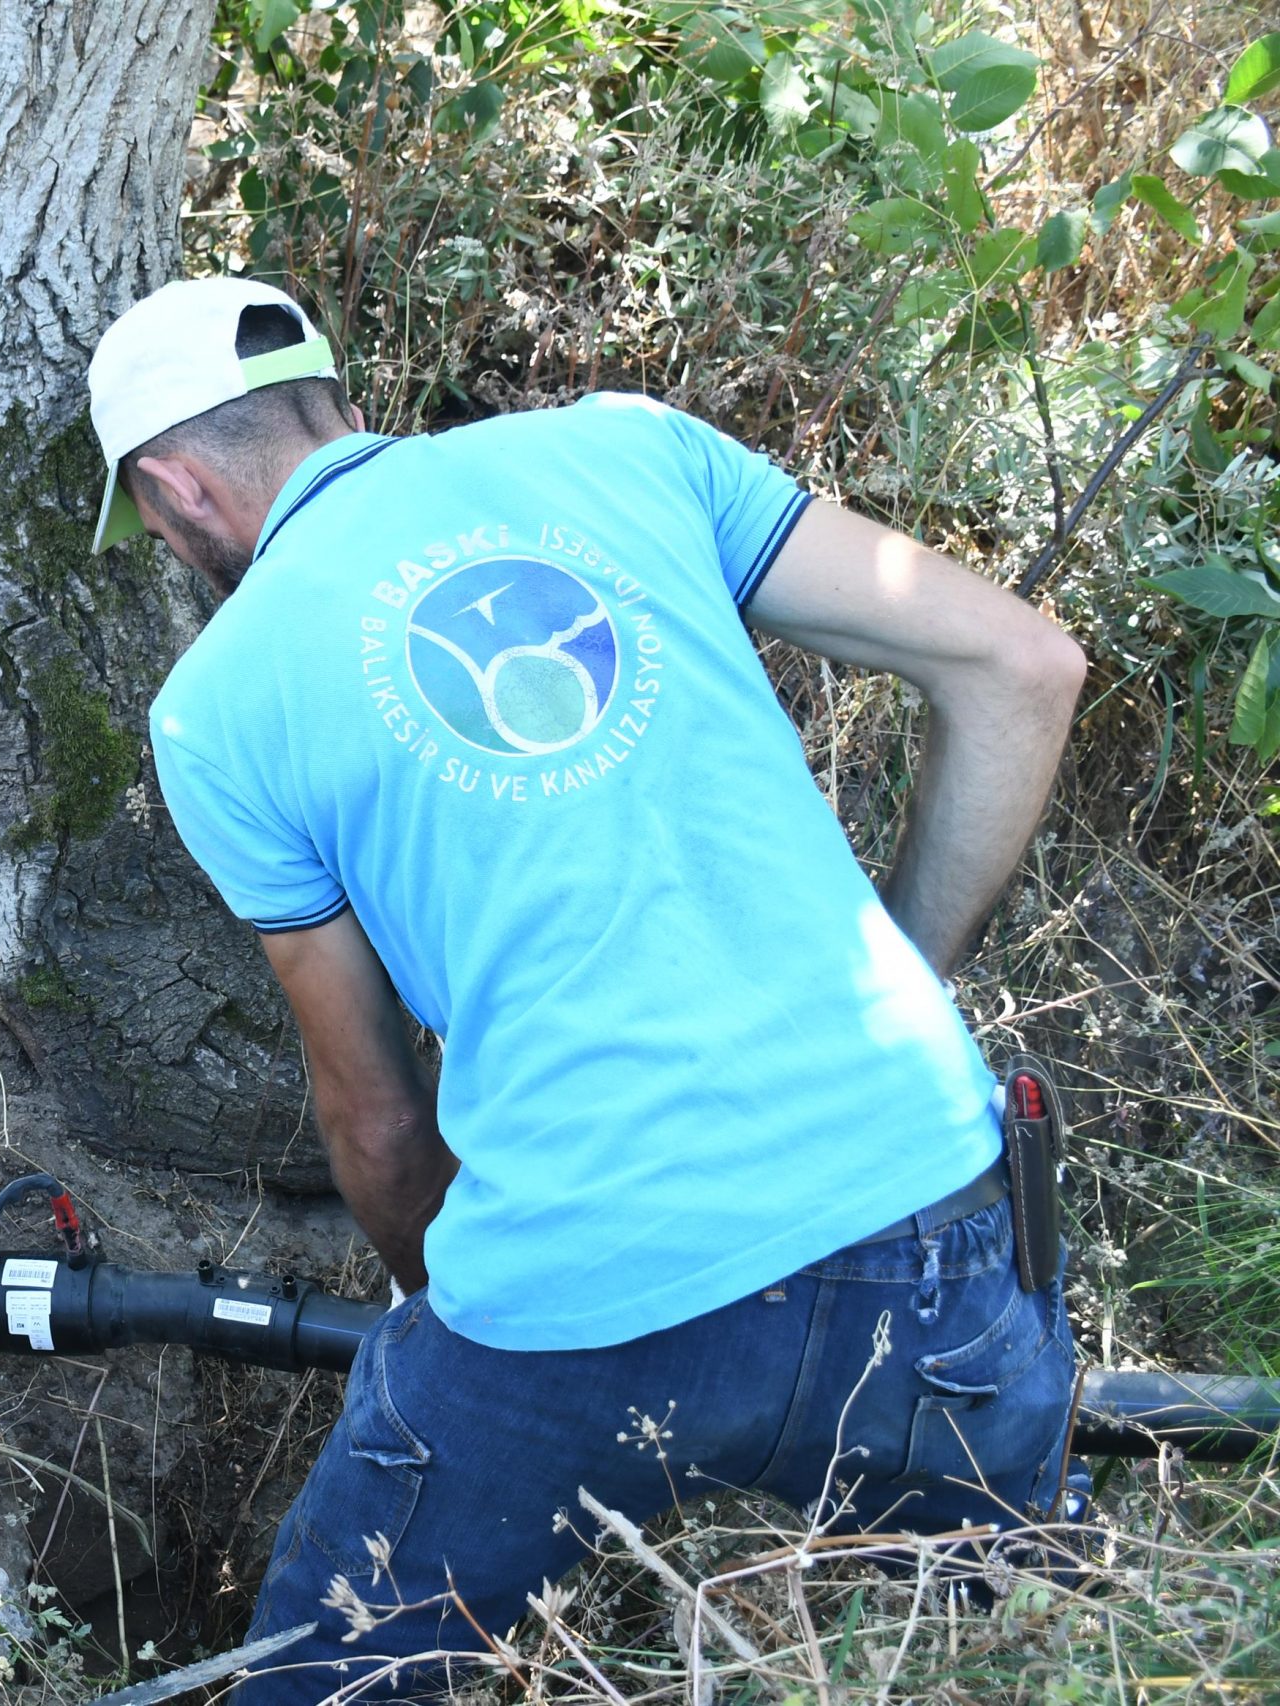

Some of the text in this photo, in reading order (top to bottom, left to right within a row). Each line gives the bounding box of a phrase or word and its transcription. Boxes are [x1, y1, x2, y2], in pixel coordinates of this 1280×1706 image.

[360, 616, 439, 767] BALIKESİR
[491, 774, 527, 801] VE
[540, 613, 664, 797] KANALİZASYON
